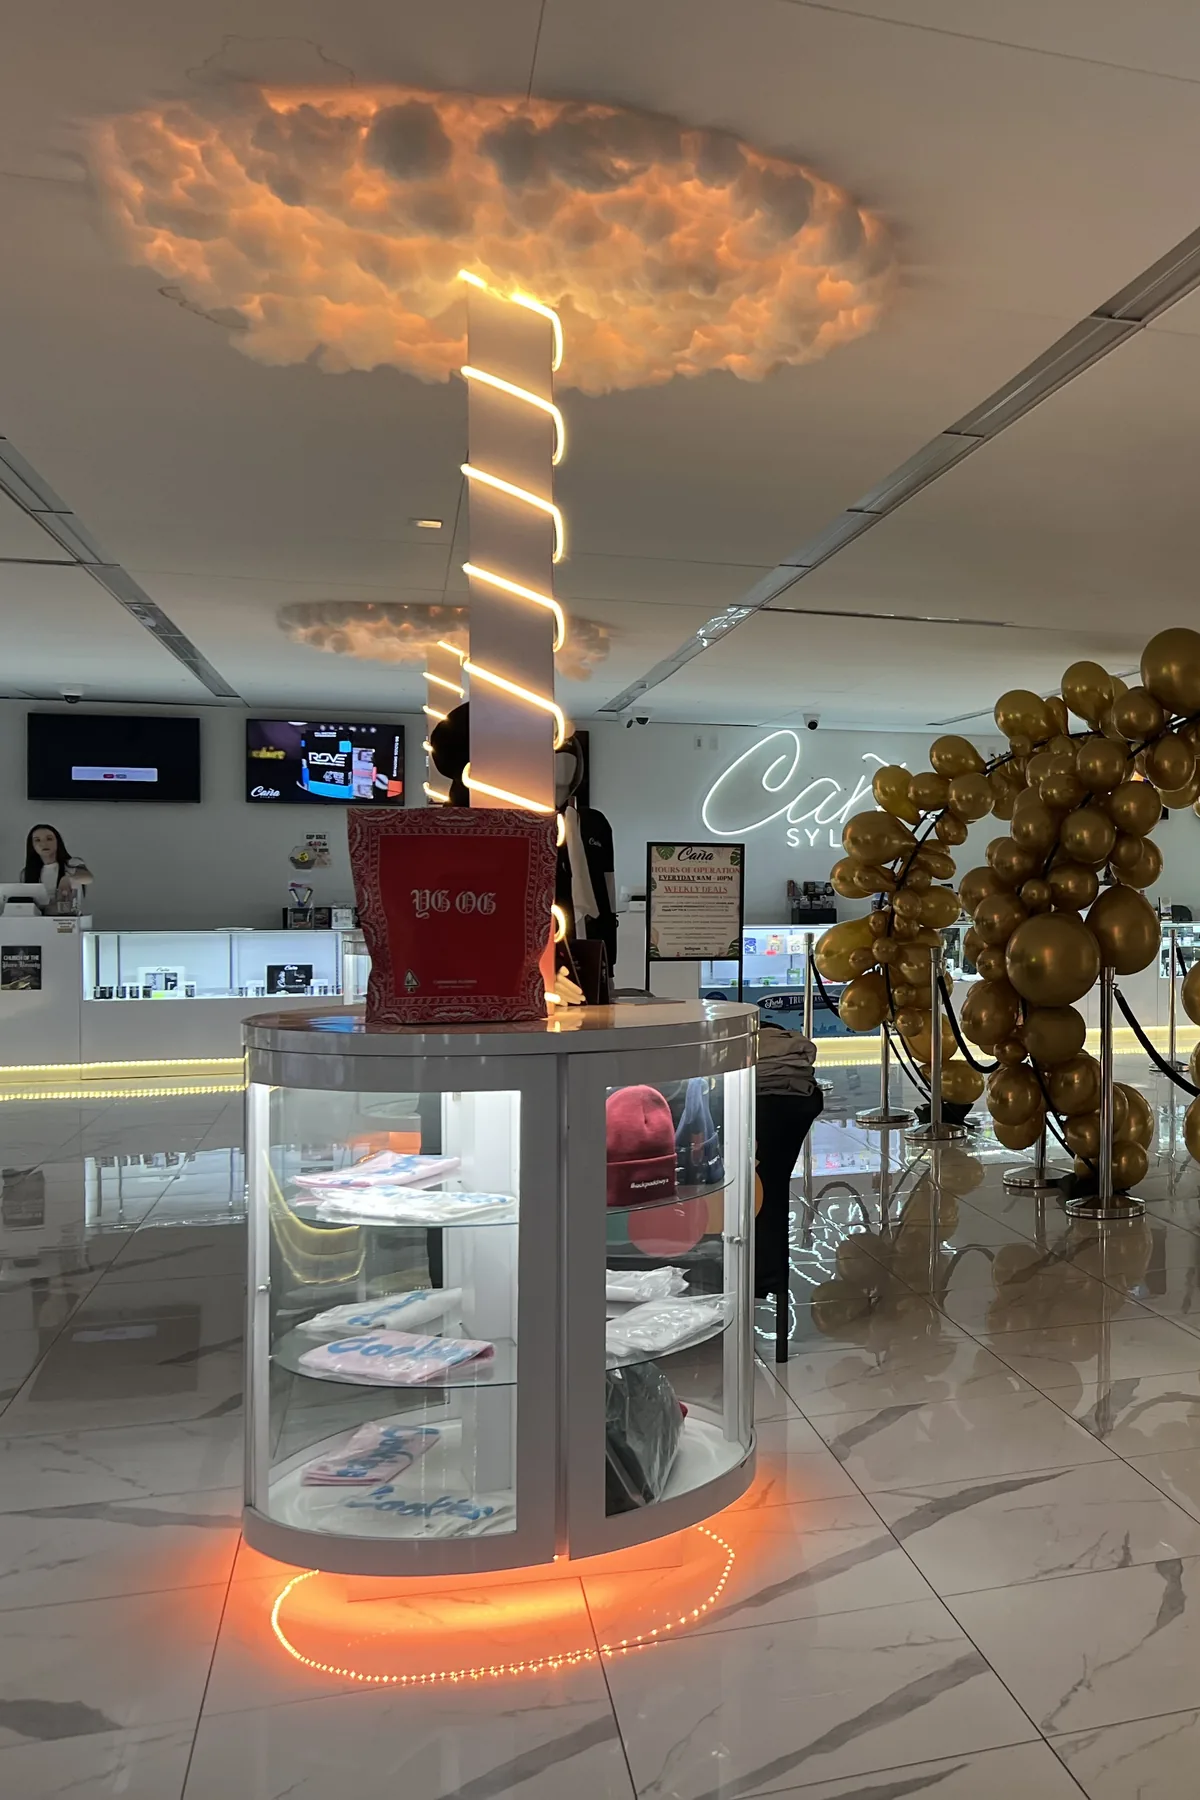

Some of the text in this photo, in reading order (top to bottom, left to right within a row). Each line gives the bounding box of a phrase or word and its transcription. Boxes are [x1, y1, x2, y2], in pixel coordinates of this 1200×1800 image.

[308, 752, 347, 765] ROVE
[786, 828, 842, 848] SYL
[678, 846, 714, 861] Caña
